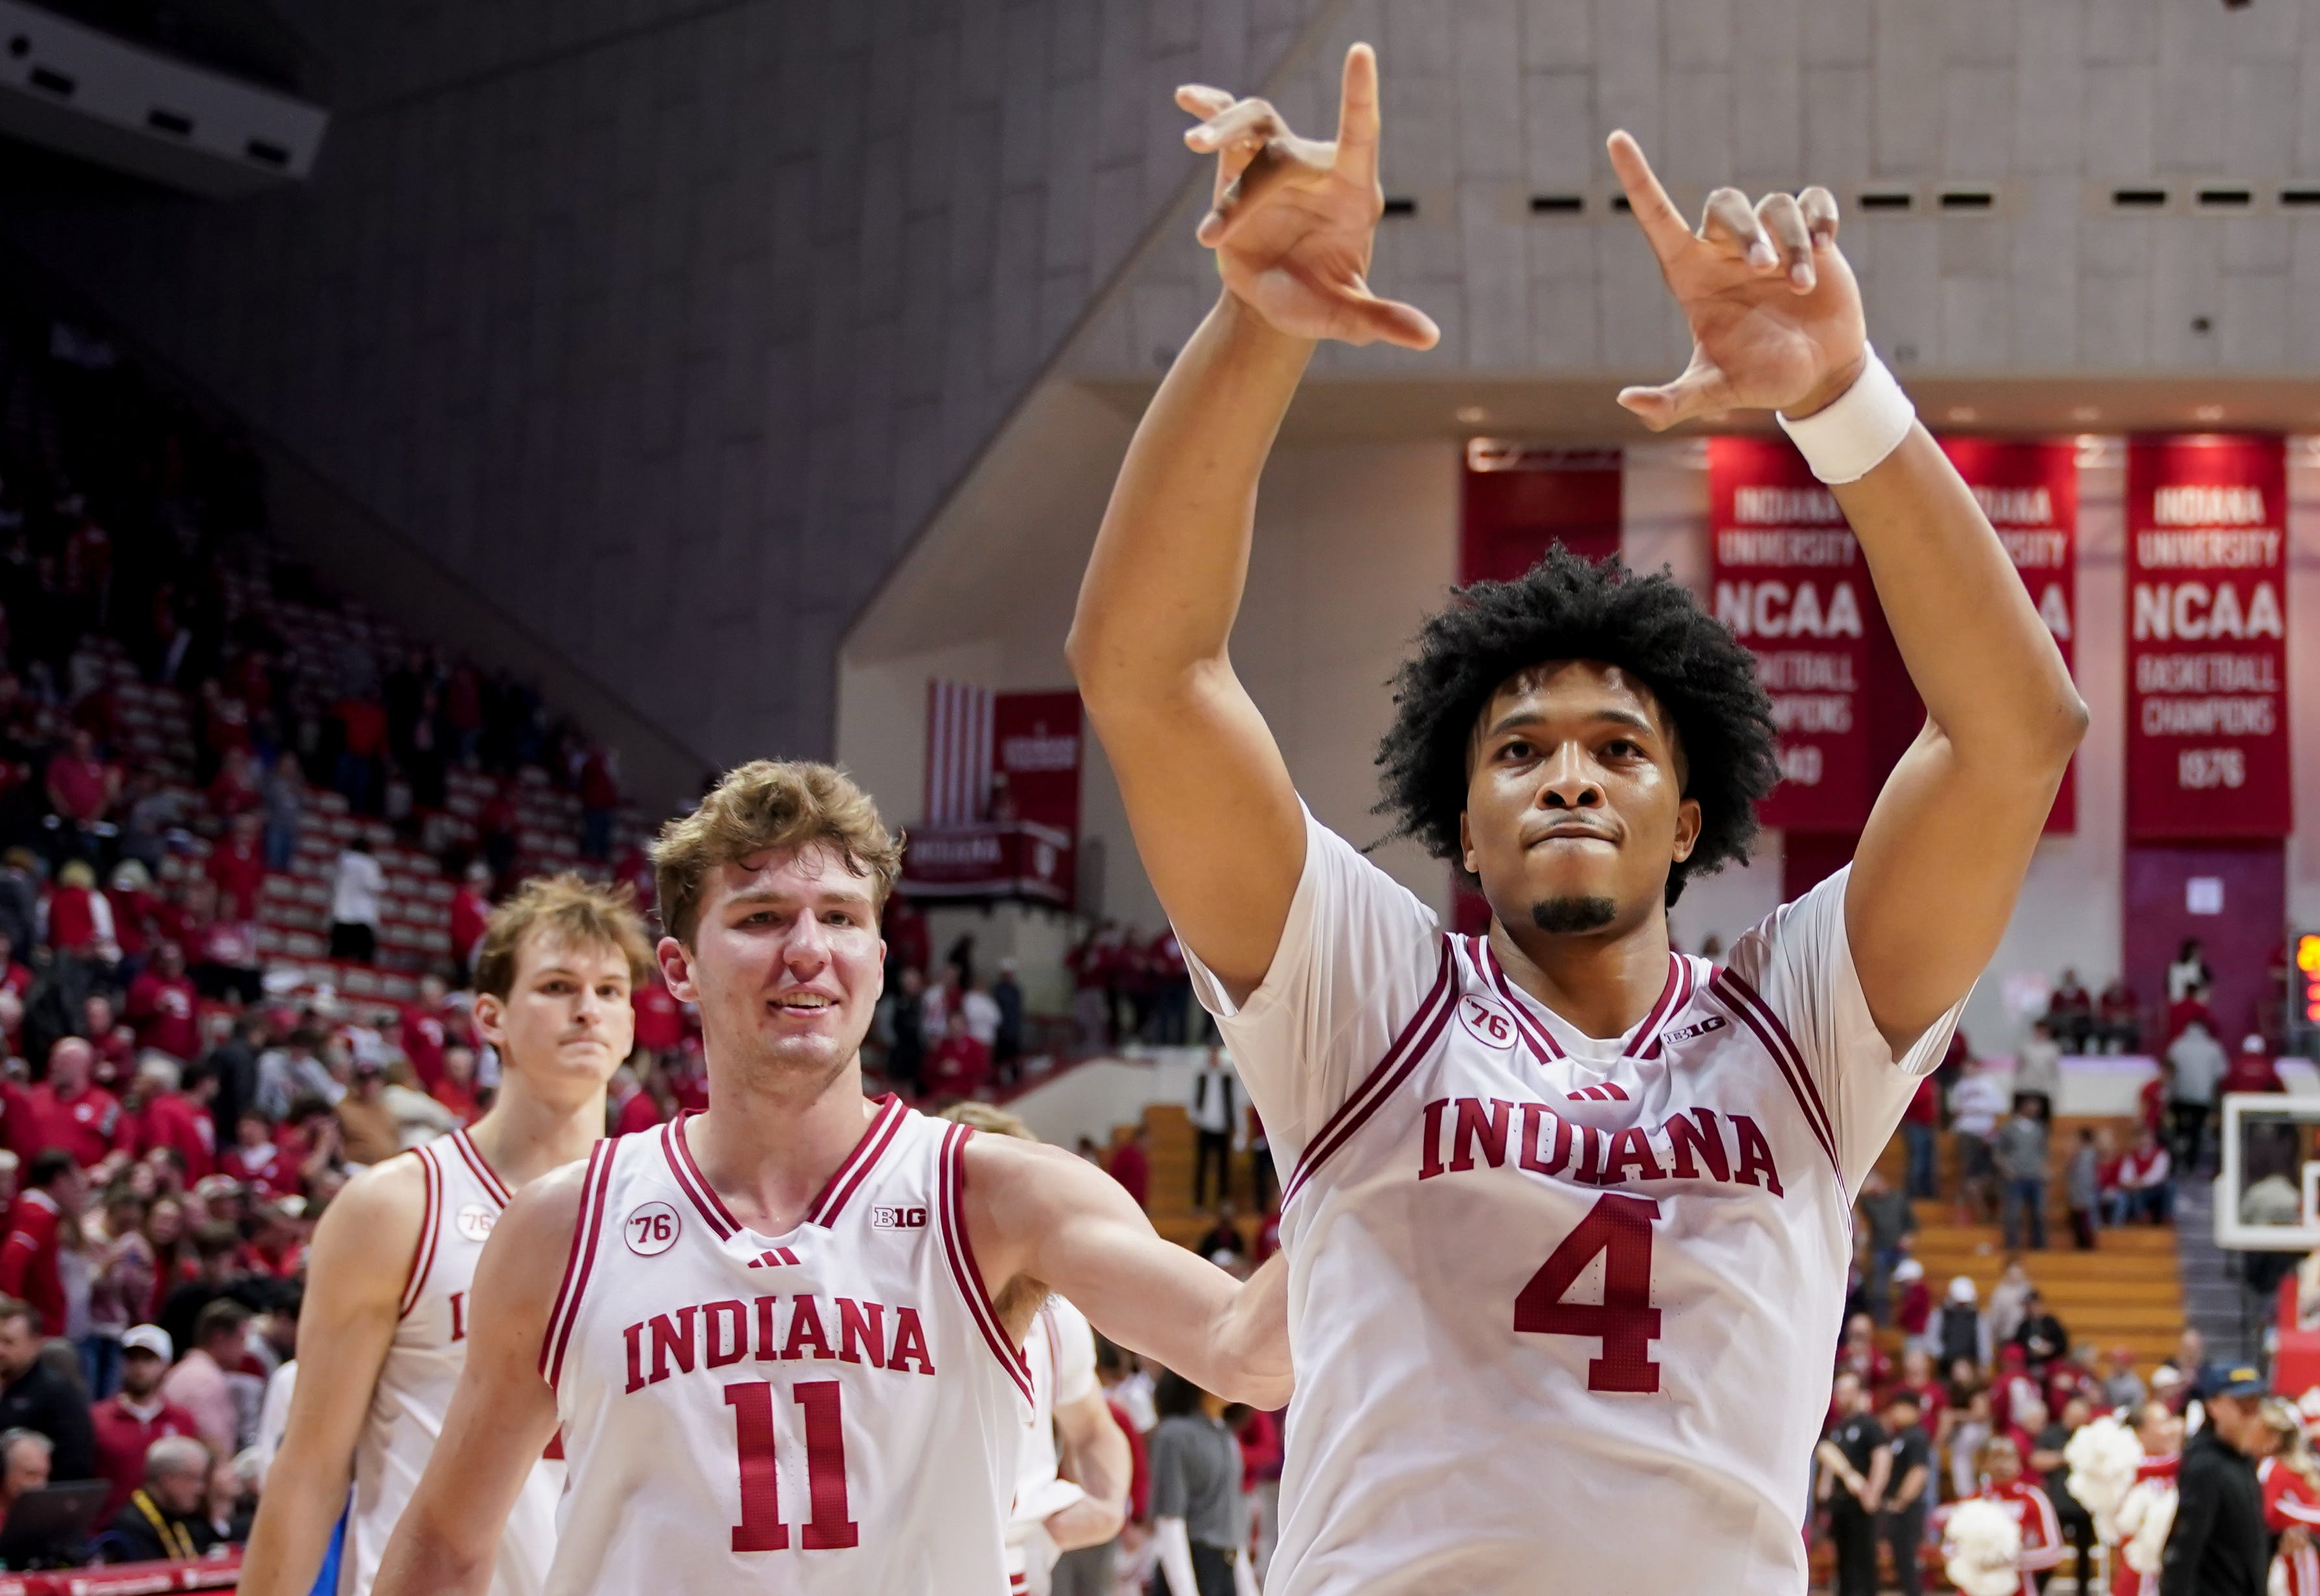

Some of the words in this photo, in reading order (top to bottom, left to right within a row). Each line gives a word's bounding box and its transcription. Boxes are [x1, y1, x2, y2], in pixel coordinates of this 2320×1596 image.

[2154, 486, 2267, 526] INDIANA
[1718, 529, 1857, 567] UNIVERSITY
[2137, 529, 2282, 569] UNIVERSITY
[1716, 581, 1863, 639] NCAA
[2133, 582, 2284, 640] NCAA
[2135, 652, 2278, 693] BASKETBALL
[2141, 696, 2275, 736] CHAMPIONS
[2178, 748, 2245, 789] 1976
[1418, 1097, 1784, 1200] INDIANA
[1513, 1193, 1662, 1393] 4
[622, 1295, 936, 1395] INDIANA
[724, 1380, 859, 1552] 11
